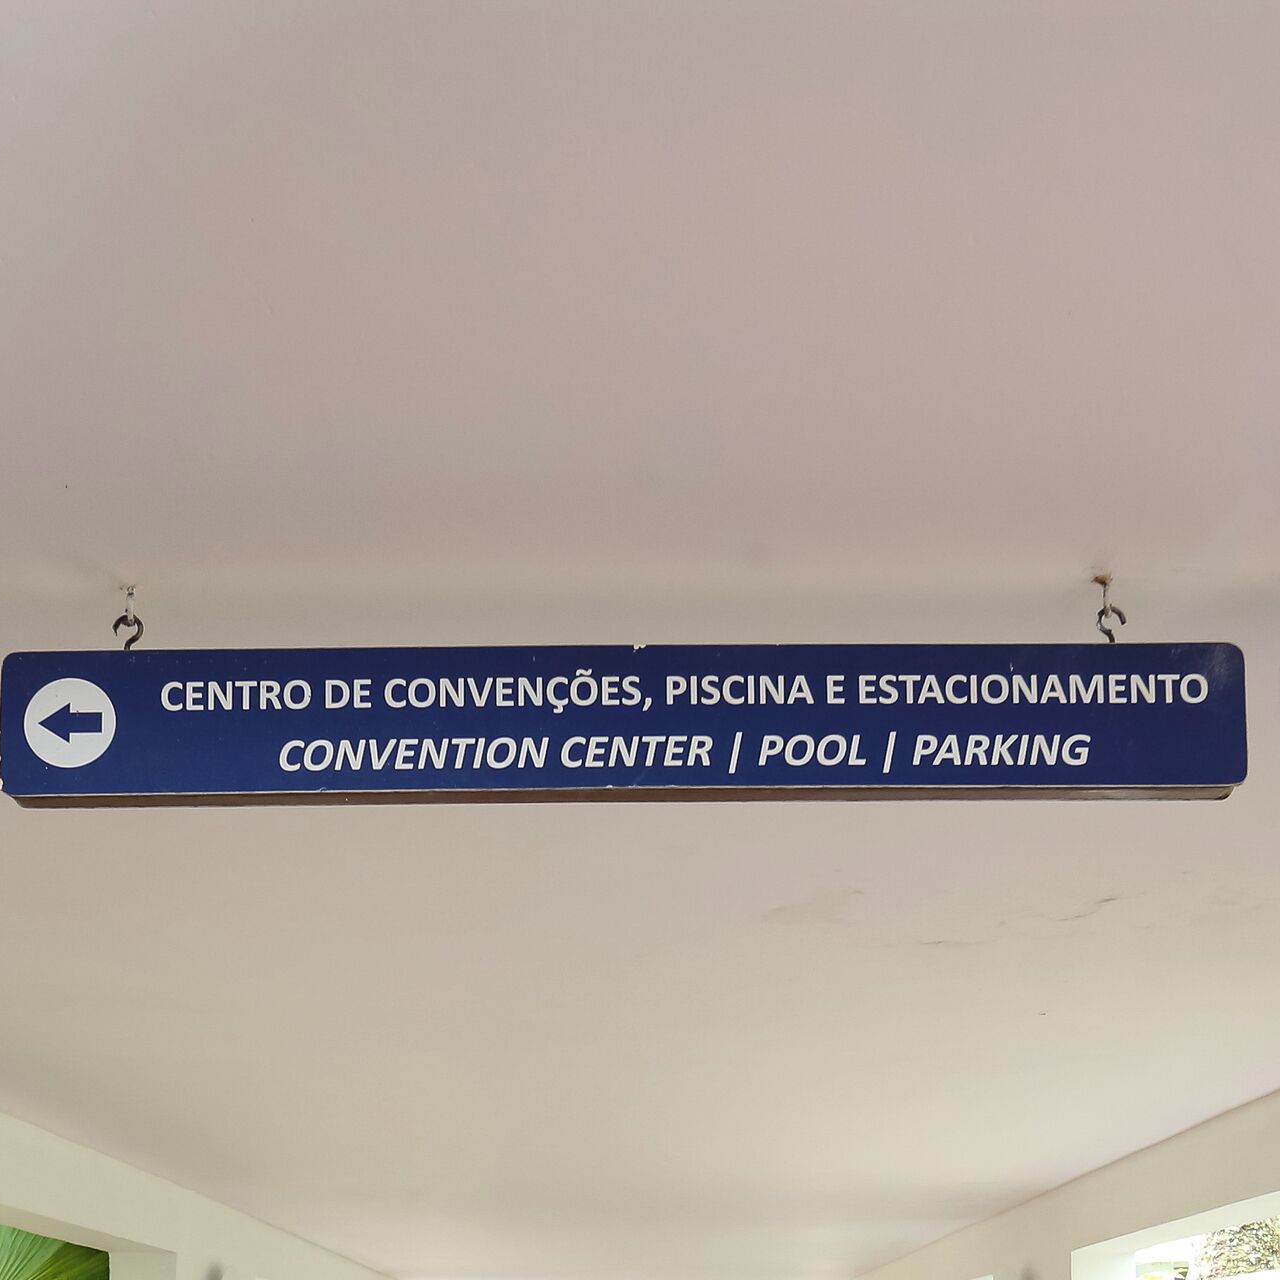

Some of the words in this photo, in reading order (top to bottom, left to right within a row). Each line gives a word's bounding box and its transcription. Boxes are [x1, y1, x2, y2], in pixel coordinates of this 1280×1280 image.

[160, 679, 312, 712] CENTRO
[325, 678, 372, 709] DE
[384, 668, 652, 714] CONVENÇÕES,
[666, 675, 815, 705] PISCINA
[826, 674, 846, 704] E
[858, 673, 1209, 705] ESTACIONAMENTO
[279, 736, 550, 772] CONVENTION
[560, 735, 713, 768] CENTER
[758, 734, 867, 766] POOL
[912, 734, 1091, 766] PARKING
